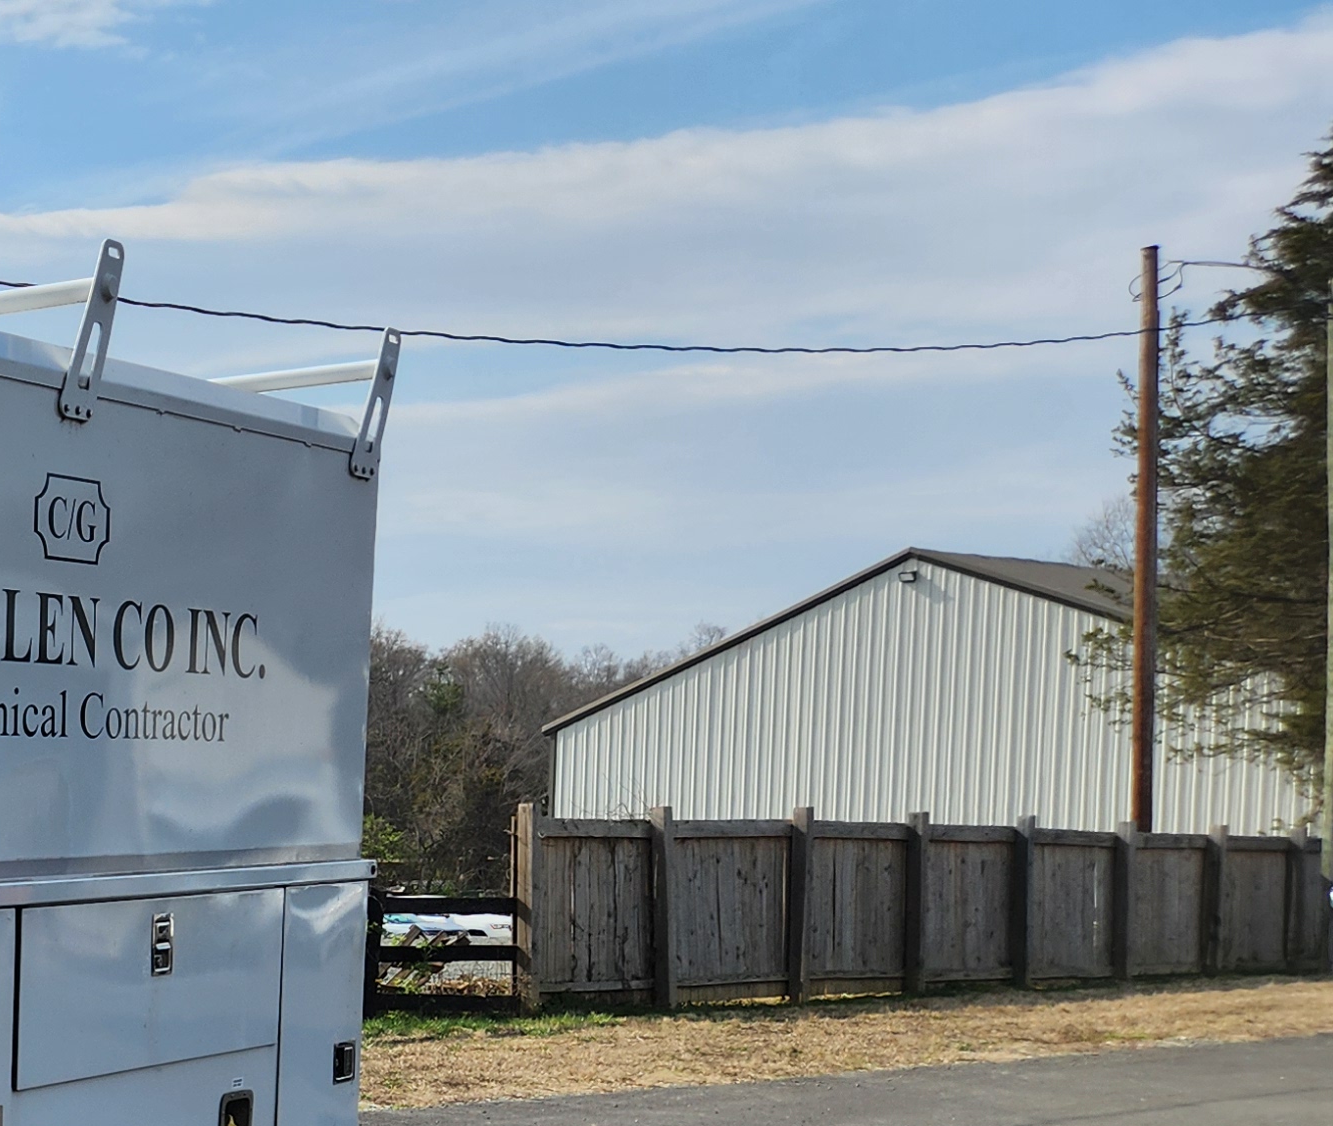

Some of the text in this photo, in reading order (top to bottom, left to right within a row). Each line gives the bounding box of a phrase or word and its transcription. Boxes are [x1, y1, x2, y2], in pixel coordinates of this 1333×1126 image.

[47, 496, 97, 543] C/G
[112, 600, 175, 673] CO
[185, 607, 267, 680] INC.
[79, 691, 231, 743] Contractor
